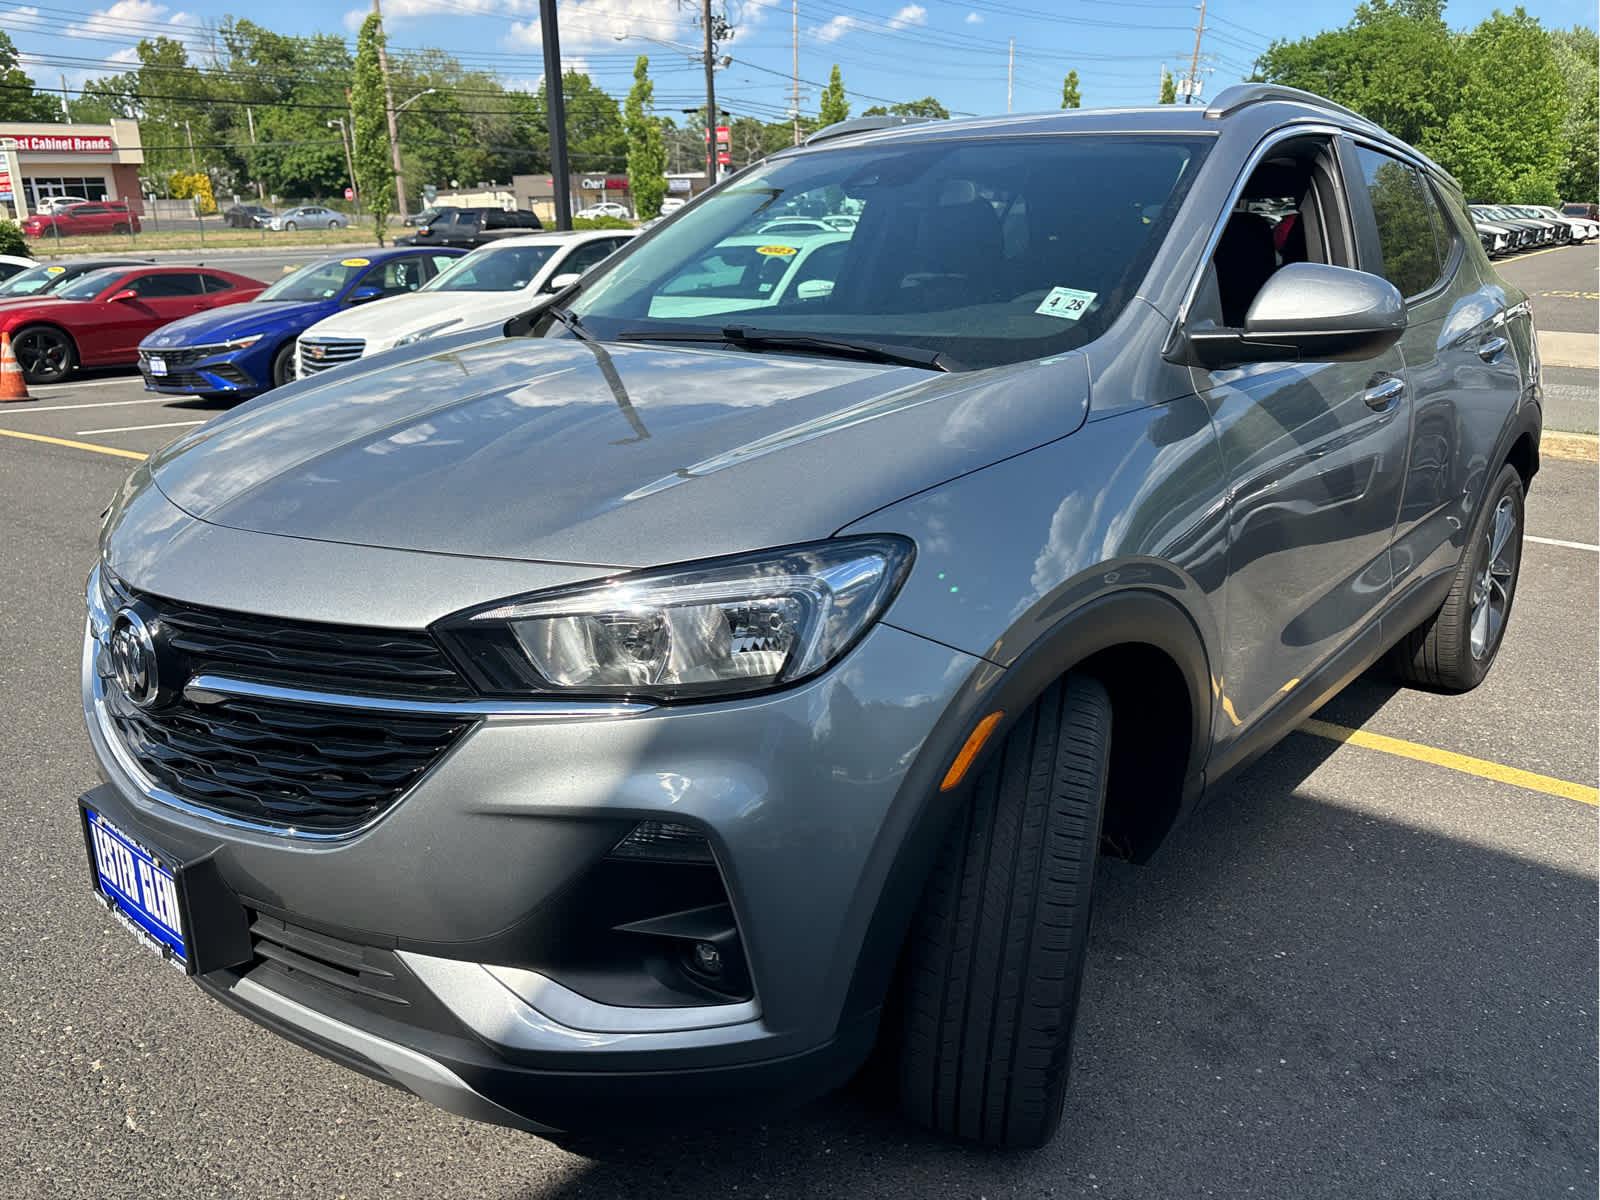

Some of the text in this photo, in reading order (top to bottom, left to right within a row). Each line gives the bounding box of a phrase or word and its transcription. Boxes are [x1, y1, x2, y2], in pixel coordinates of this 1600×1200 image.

[31, 137, 73, 150] Cabinet
[74, 138, 111, 150] Brands
[1049, 296, 1085, 311] 4 28
[91, 822, 140, 905] LESTER
[138, 858, 183, 937] GLENN
